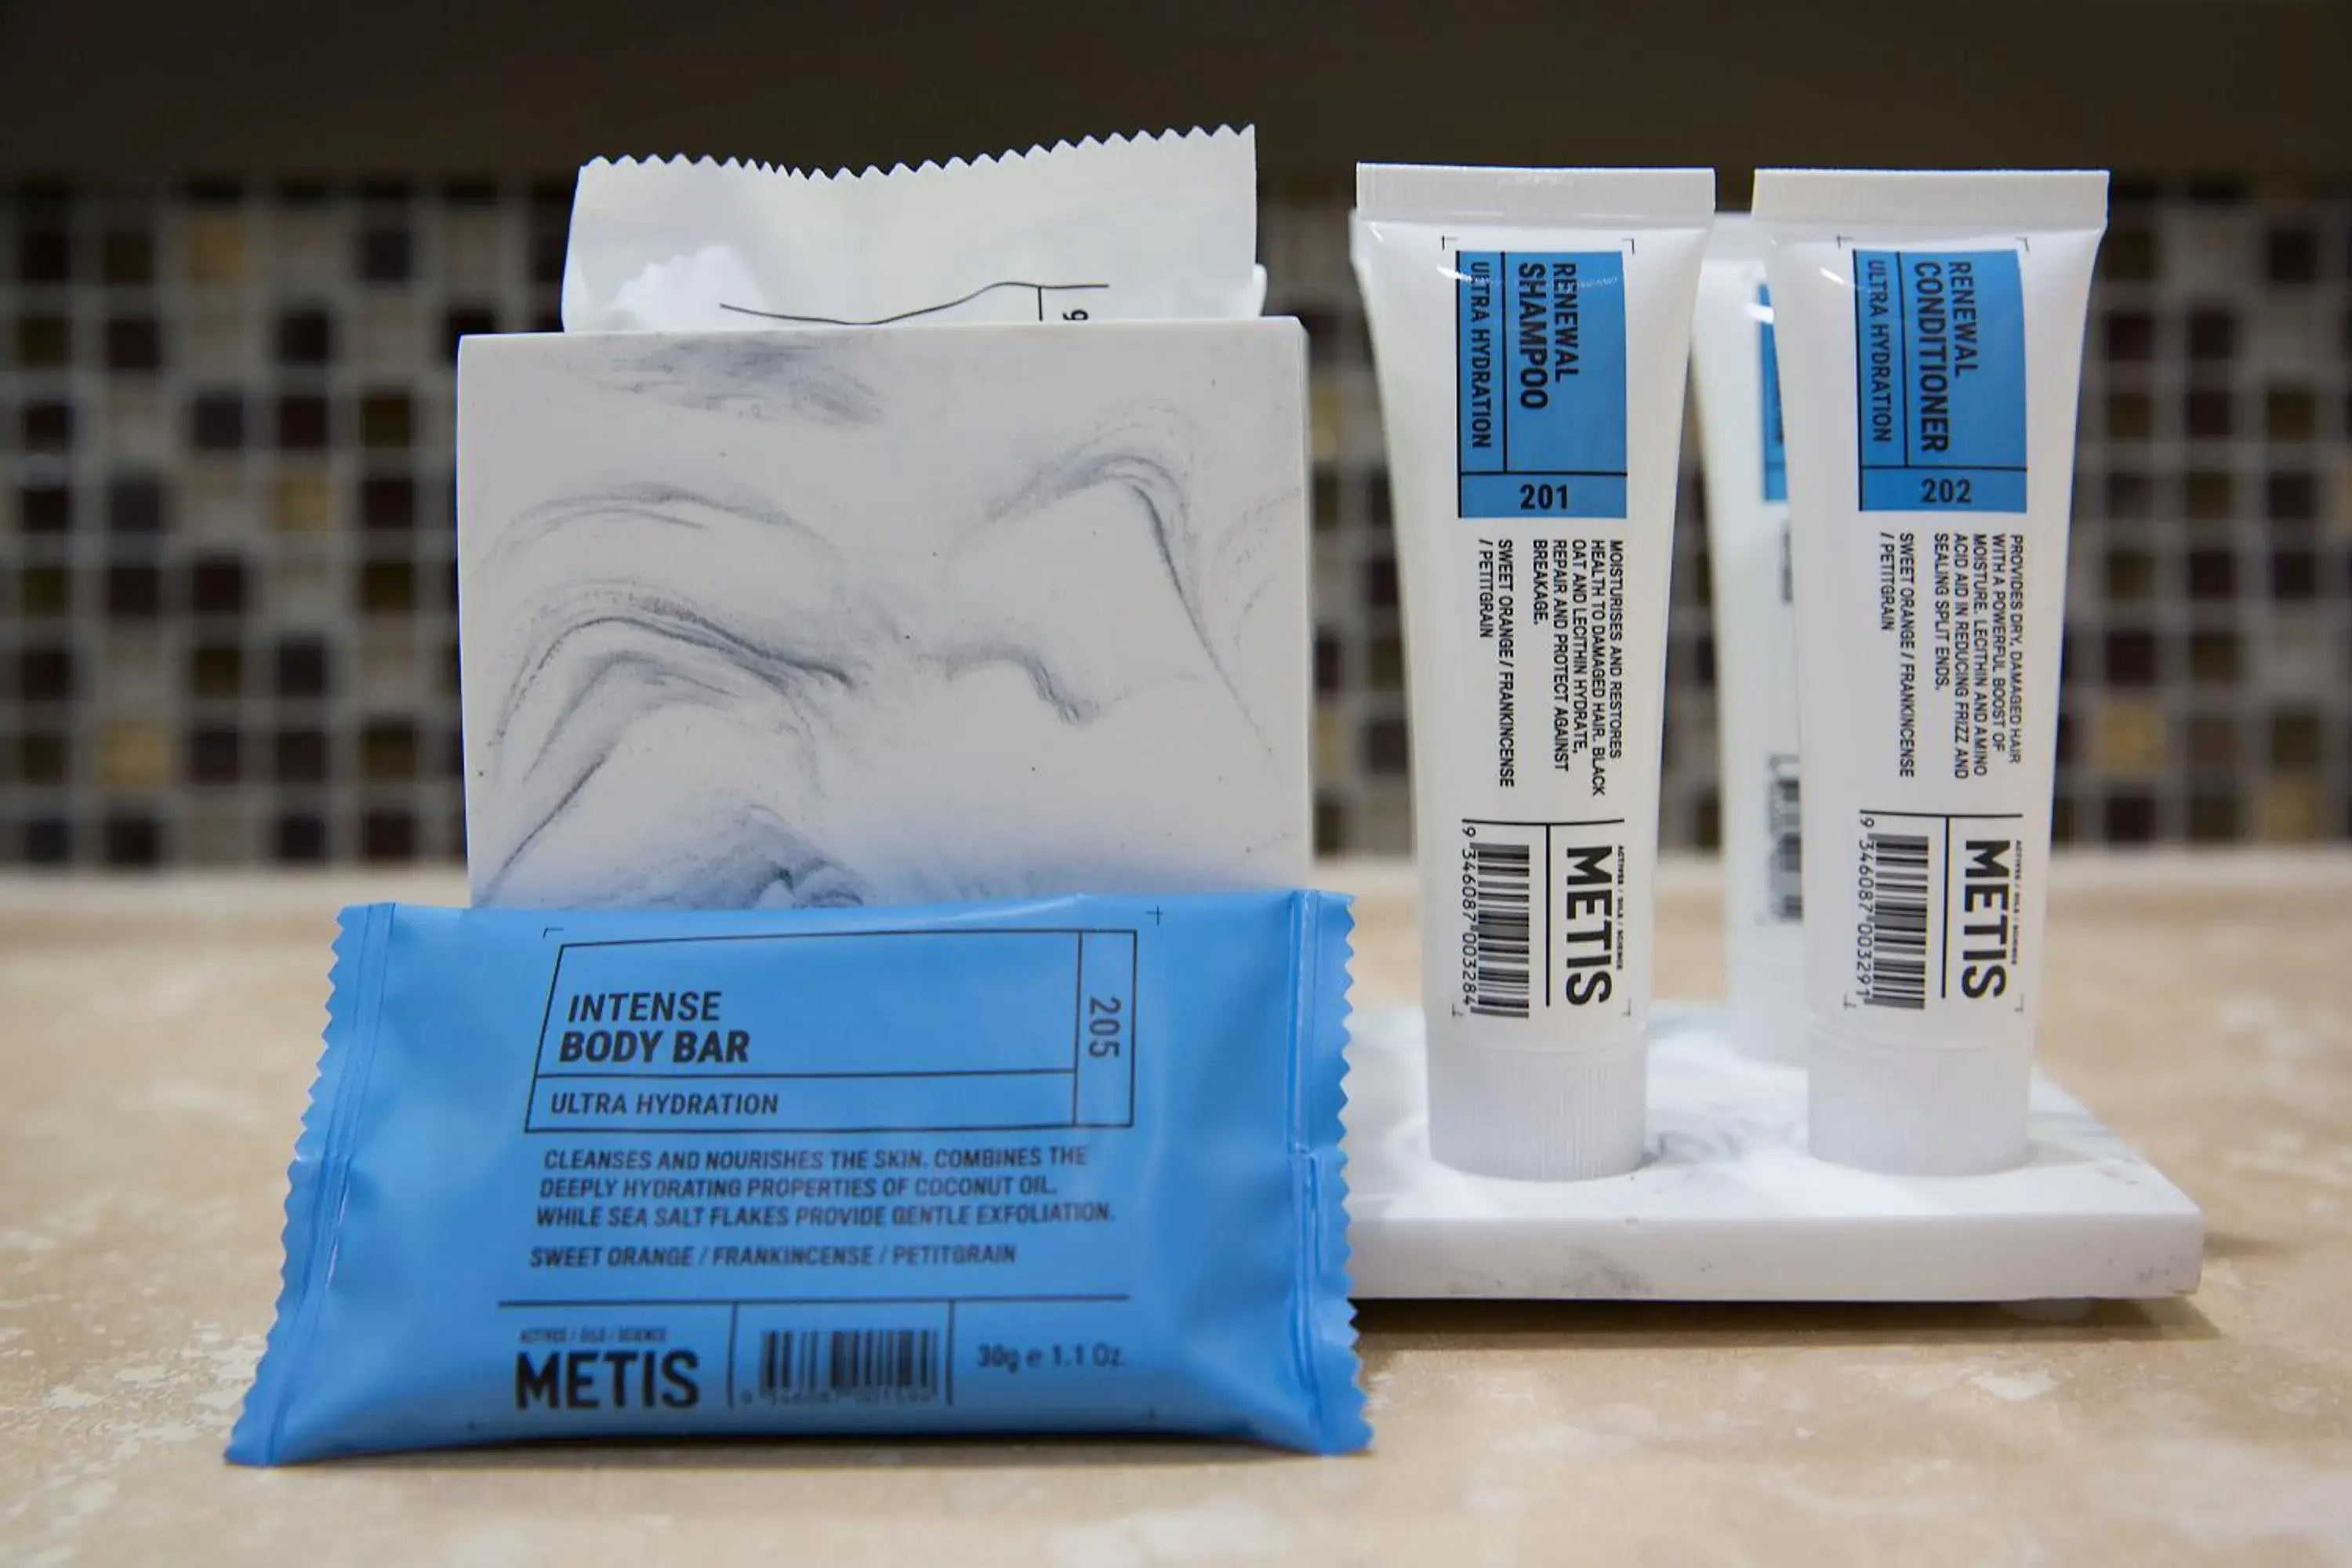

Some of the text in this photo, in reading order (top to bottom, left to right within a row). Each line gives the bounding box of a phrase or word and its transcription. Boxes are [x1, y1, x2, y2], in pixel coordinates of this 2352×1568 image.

[1470, 262, 1491, 448] ULTRA HYDRATION
[1519, 263, 1548, 409] SHAMPOO
[1553, 263, 1579, 382] RENEWAL
[1867, 260, 1891, 441] ULTRA HYDRATION
[1915, 262, 1948, 452] CONDITIONER
[1949, 261, 1977, 376] RENEWAL
[1519, 484, 1568, 510] 201
[1921, 479, 1972, 503] 202
[1479, 550, 1494, 638] PETITGRAIN
[1498, 539, 1513, 590] SWEET
[1534, 539, 1548, 625] BREAKAGE.
[1881, 544, 1894, 631] PETITGRAIN
[1900, 533, 1914, 584] SWEET
[2009, 534, 2023, 610] PROVIDES
[1498, 595, 1513, 657] ORANGE
[1571, 539, 1588, 753] OAT AND LECITHIN HYDRATE,
[1609, 539, 1622, 759] MOISTURISES AND RESTORES
[1900, 588, 1915, 649] ORANGE
[1935, 533, 1949, 690] SEALING SPLIT ENDS.
[1992, 534, 2006, 752] WITH A POWERFUL BOOST OF
[1554, 539, 1568, 771] REPAIR AND PROTECT AGAINST
[1592, 539, 1606, 796] HEALTH TO DAMAGED HAIR. BLACK
[1955, 533, 1969, 779] ACID AID IN REDUCING FRIZZ AND
[1973, 620, 1987, 687] LECITHIN
[2009, 651, 2023, 724] DAMAGED
[1499, 672, 1514, 787] FRANKINCENSE
[1900, 663, 1915, 777] FRANKINCENSE
[1974, 691, 1987, 723] AND
[2009, 728, 2022, 764] HAIR
[1973, 727, 1987, 775] AMINO
[1462, 826, 1477, 1005] 9 346087 003284
[1566, 846, 1612, 1005] METIS
[1857, 818, 1874, 998] 9 346087 003291
[1962, 840, 2010, 999] METIS
[559, 1030, 750, 1063] BODY BAR
[568, 990, 722, 1023] INTENSE
[1089, 995, 1120, 1058] 205
[550, 1092, 779, 1115] ULTRA HYDRATION
[541, 1178, 617, 1198] DEEPLY
[623, 1178, 741, 1198] HYDRATING
[748, 1177, 877, 1198] PROPERTIES
[882, 1177, 909, 1197] OF
[915, 1176, 1012, 1196] COCONUT
[545, 1146, 1087, 1170] CLEANSES AND NOURISHES THE SKIN. COMBINES THE
[537, 1202, 1116, 1227] WHILE SEA SALT FLAKES PROVIDE GENTLE EXFOLIATION.
[530, 1247, 601, 1268] SWEET
[608, 1247, 692, 1267] ORANGE
[698, 1247, 707, 1267] /
[713, 1246, 874, 1266] FRANKINCENSE
[894, 1245, 1015, 1264] PETITGRAIN
[514, 1349, 699, 1410] METIS
[977, 1343, 1020, 1374] 30g
[1026, 1345, 1044, 1368] e
[1052, 1343, 1084, 1368] 1.1
